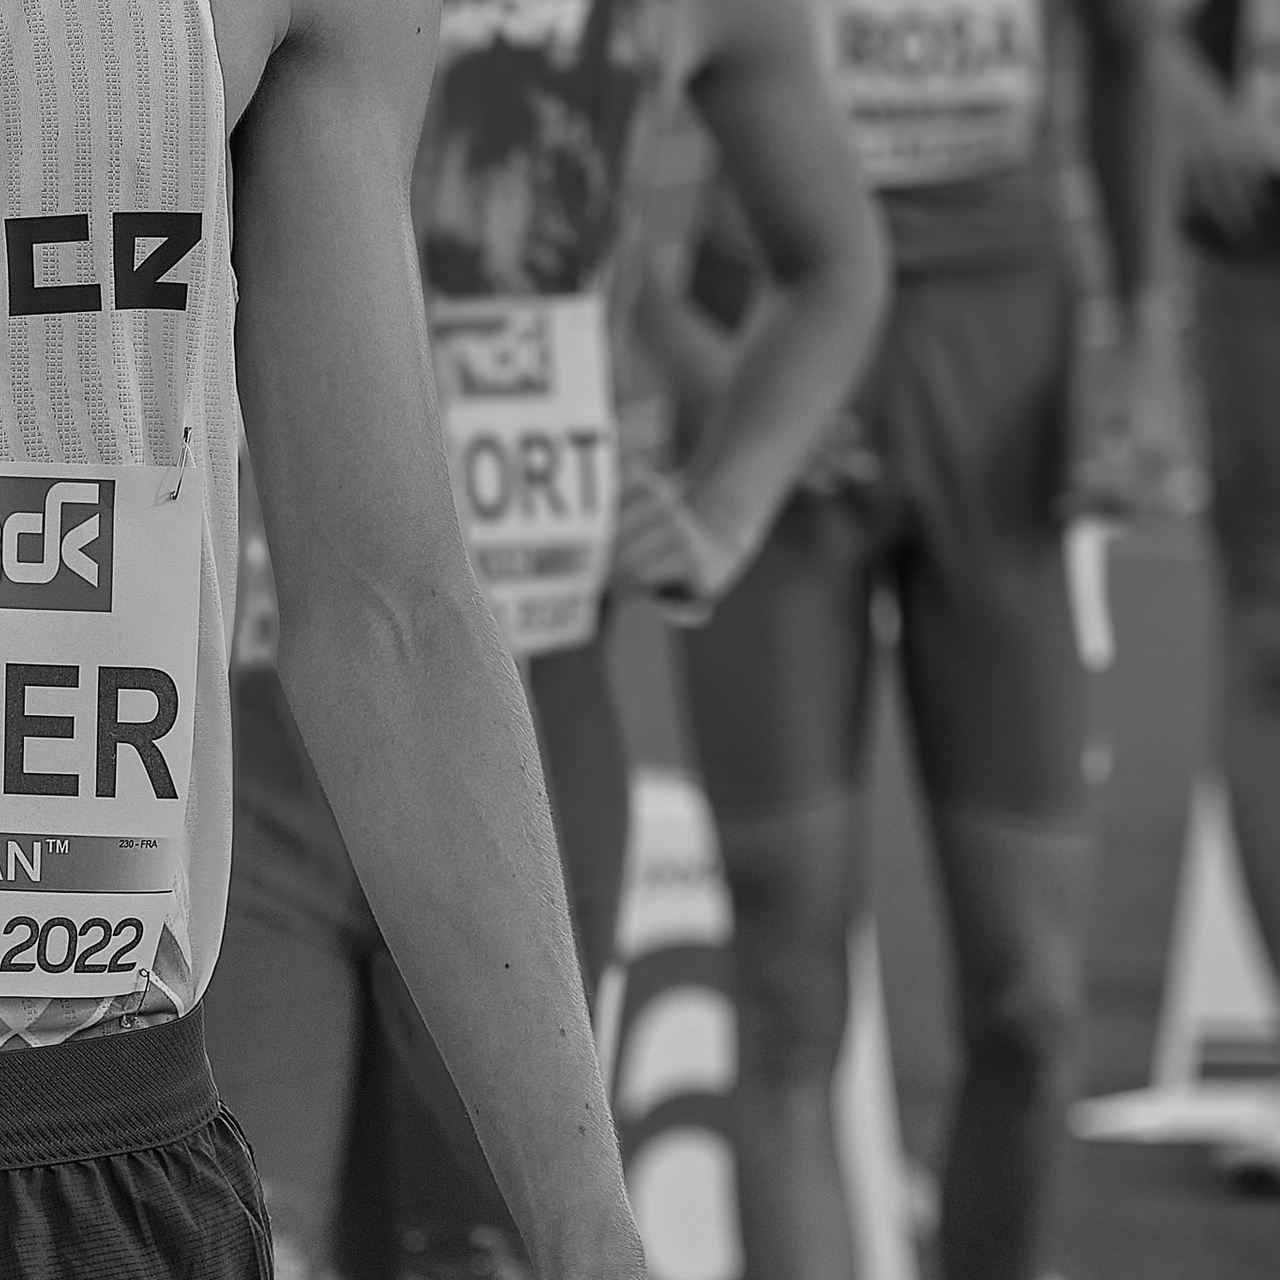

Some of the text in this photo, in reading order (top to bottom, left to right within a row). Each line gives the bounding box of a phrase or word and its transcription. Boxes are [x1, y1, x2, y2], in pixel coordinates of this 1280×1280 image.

[118, 839, 134, 848] 230
[140, 839, 158, 848] FRA
[0, 917, 145, 974] 2022
